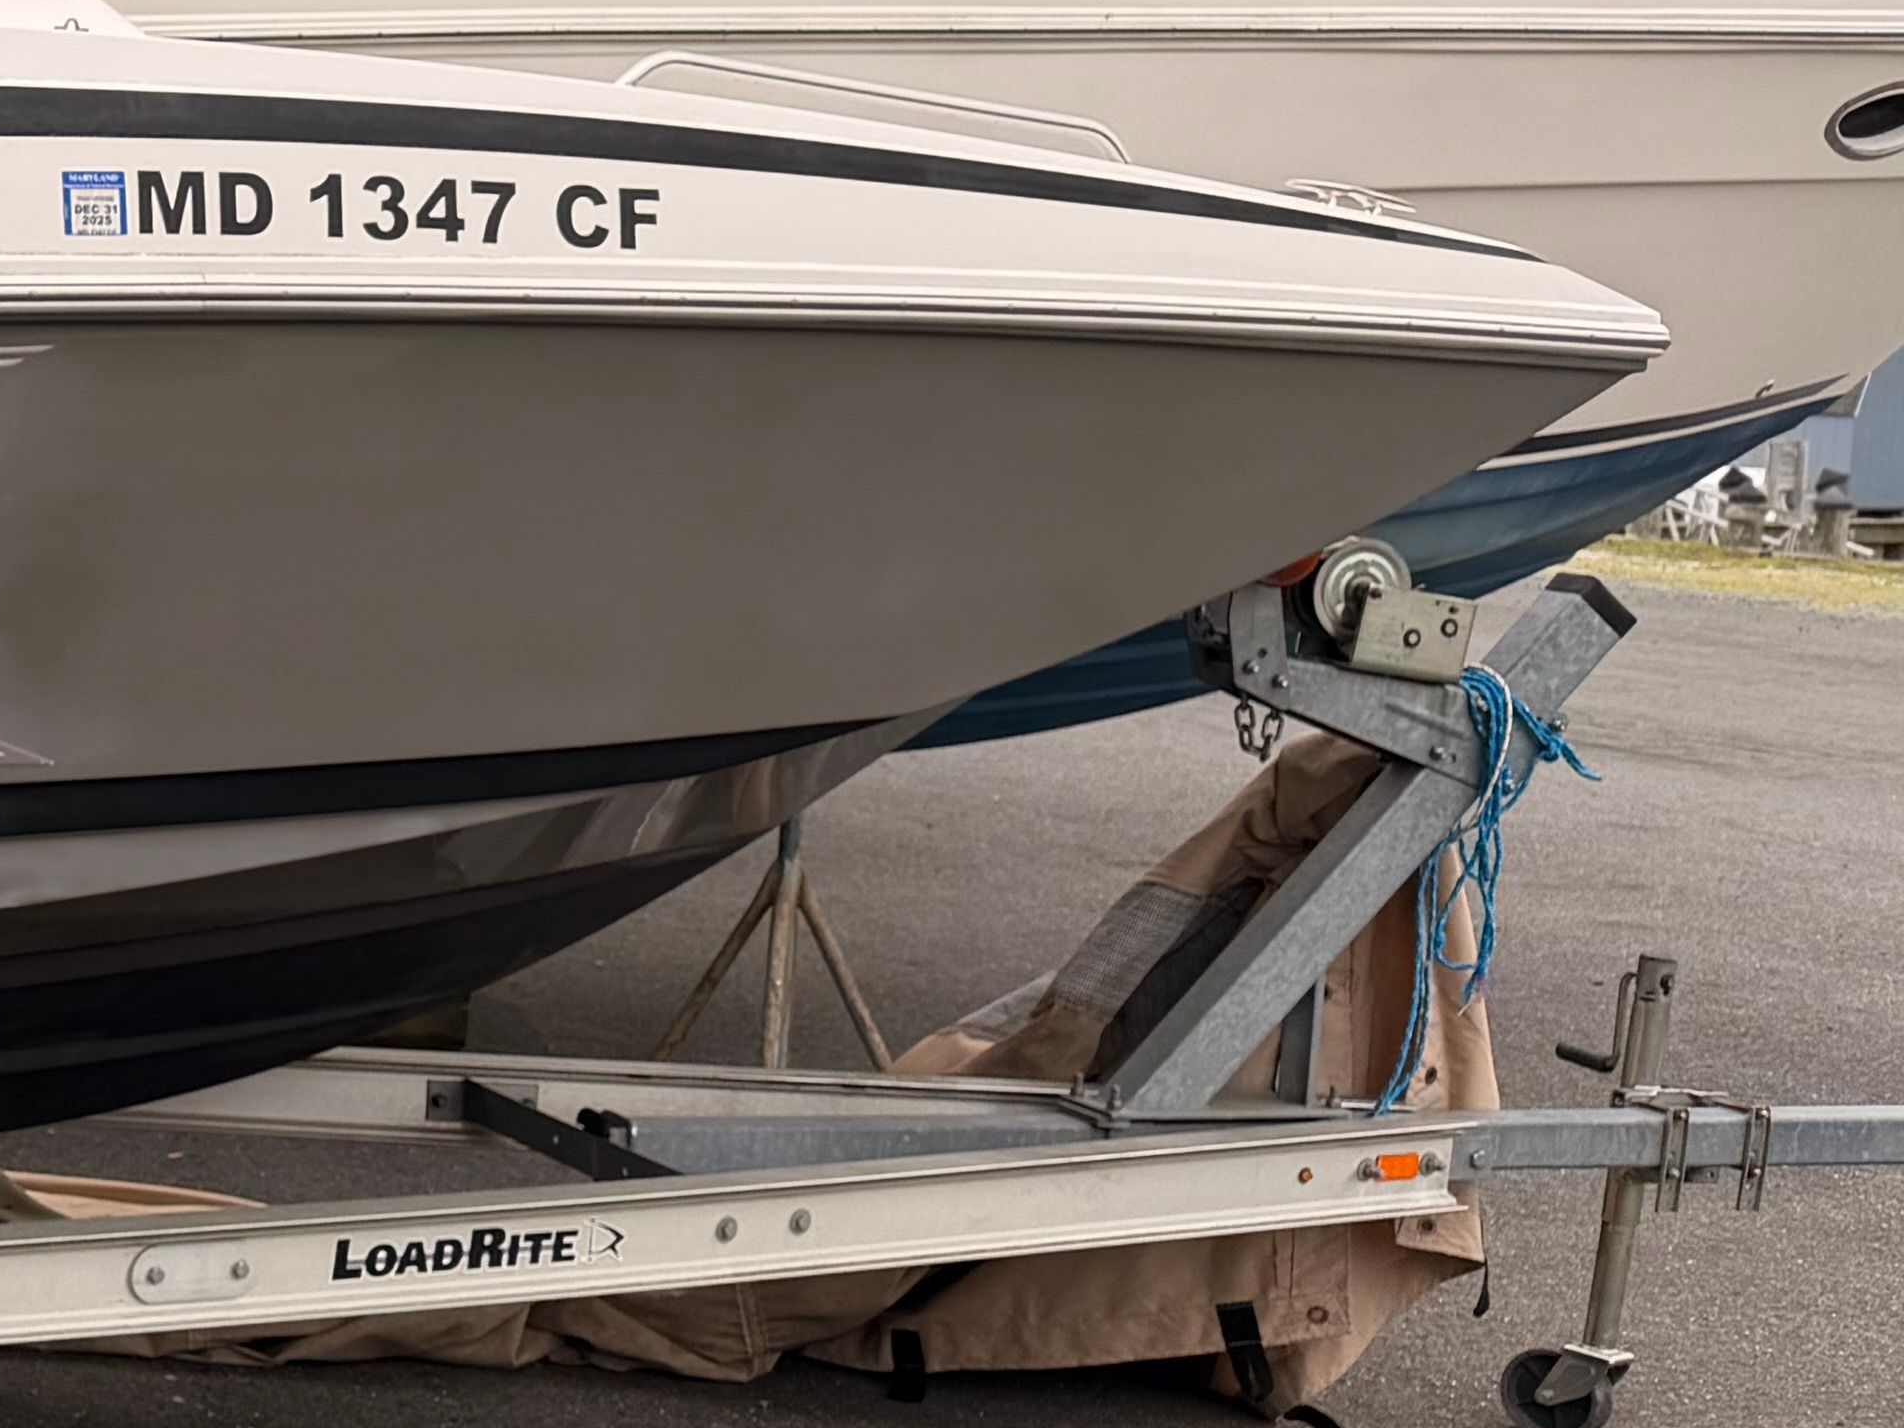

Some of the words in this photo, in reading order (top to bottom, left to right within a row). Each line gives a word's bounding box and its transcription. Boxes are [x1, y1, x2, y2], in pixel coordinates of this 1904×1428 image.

[68, 173, 120, 183] MARYLAND
[74, 204, 100, 215] DEC
[104, 204, 118, 215] 31
[137, 170, 273, 236] MD
[310, 174, 517, 244] 1347
[556, 186, 662, 250] CF
